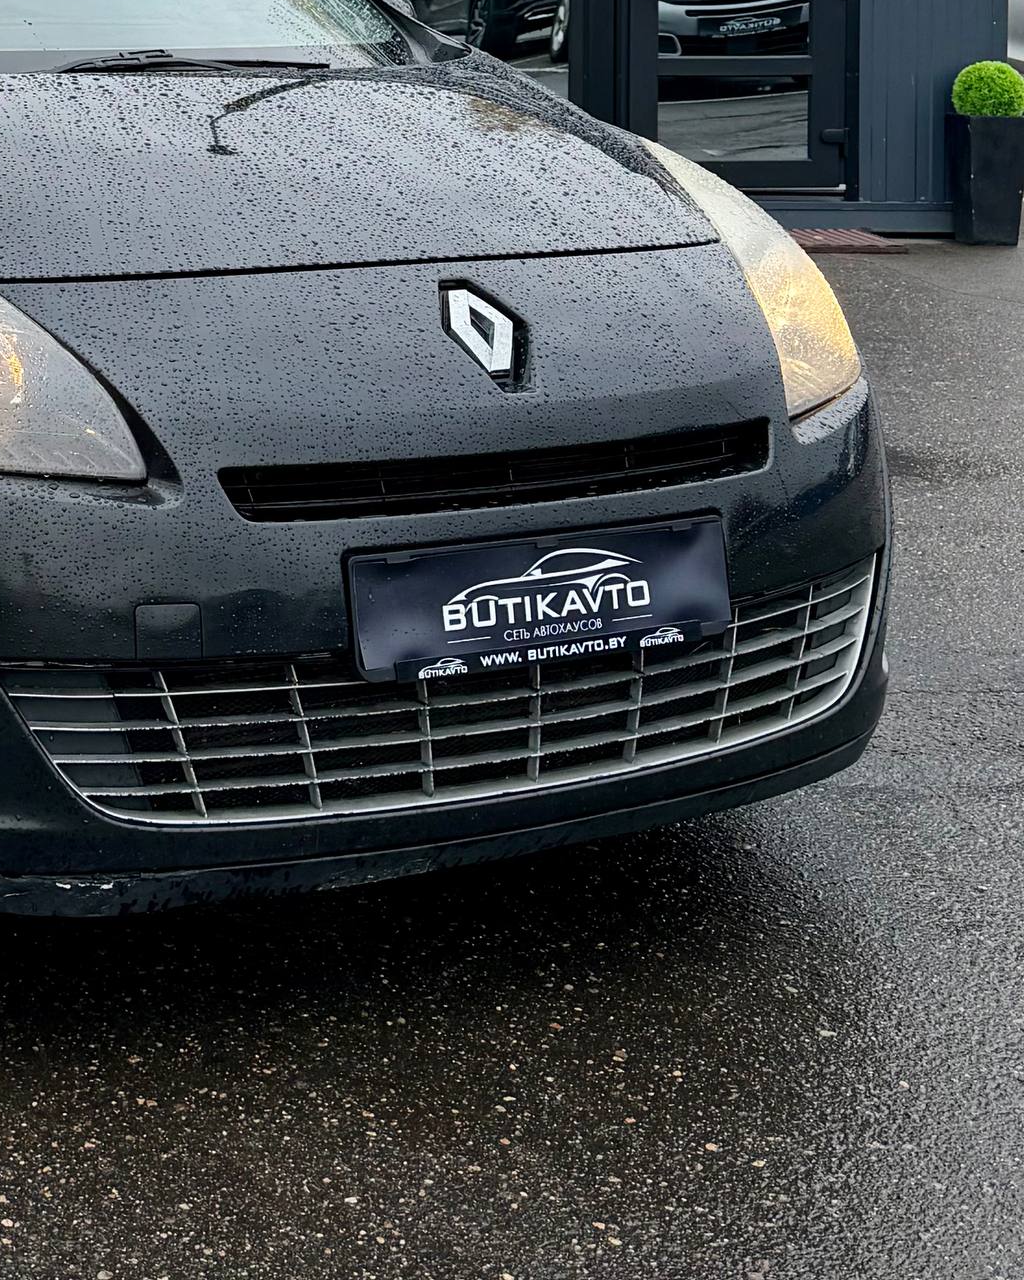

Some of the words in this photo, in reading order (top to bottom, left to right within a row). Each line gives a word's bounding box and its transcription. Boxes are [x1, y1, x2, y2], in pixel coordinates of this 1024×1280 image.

[442, 580, 651, 632] BUTIKAVTO
[503, 628, 531, 642] СЕТЬ
[533, 618, 603, 639] АВТОХАУСОВ
[639, 634, 685, 648] BUTIKAVTO
[480, 651, 523, 667] WWW.
[527, 636, 627, 661] BUTIKAVTO.BY
[418, 665, 468, 679] BUTIKAVTO
